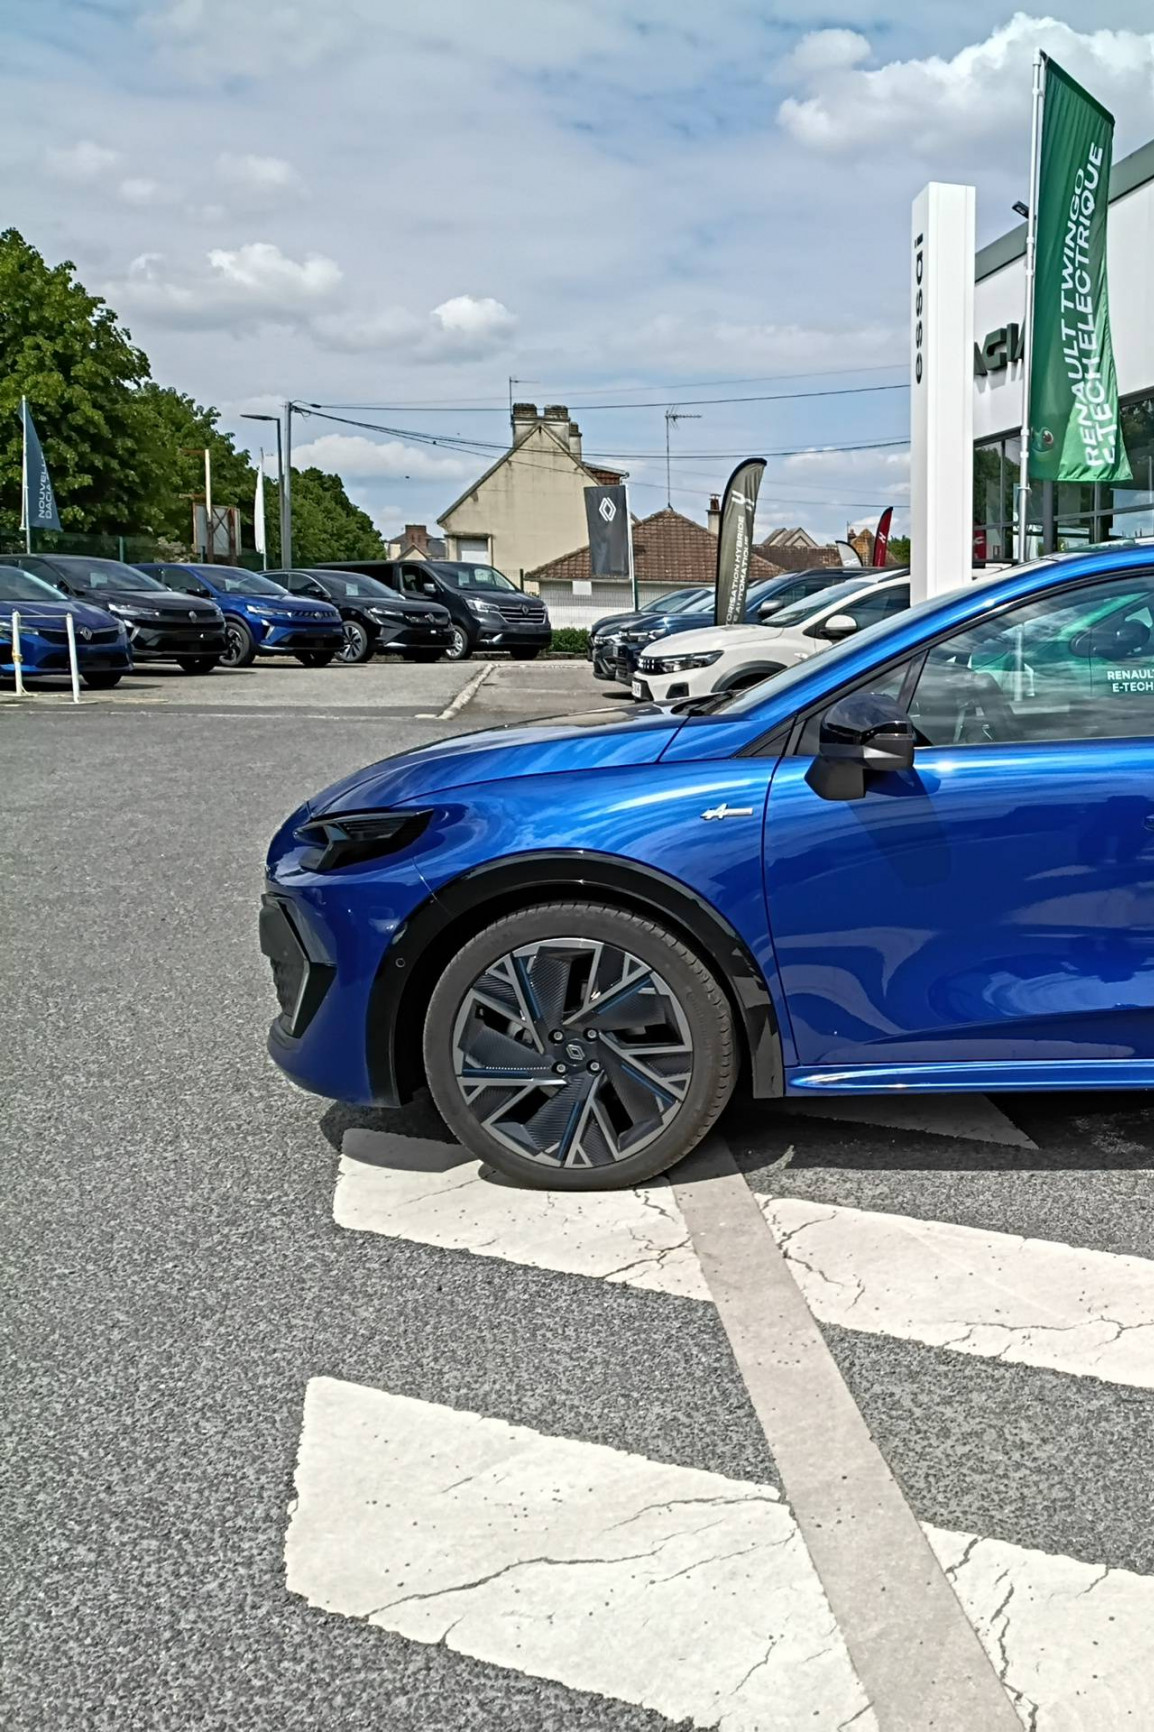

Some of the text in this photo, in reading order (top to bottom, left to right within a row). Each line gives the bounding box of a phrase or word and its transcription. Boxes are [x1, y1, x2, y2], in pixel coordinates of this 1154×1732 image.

[914, 232, 923, 384] essai
[1061, 169, 1104, 467] RENAULT TWINGO
[1075, 142, 1103, 350] ELECTRIQUE
[735, 516, 745, 563] HYBRIDE
[1112, 681, 1154, 692] E-TECH
